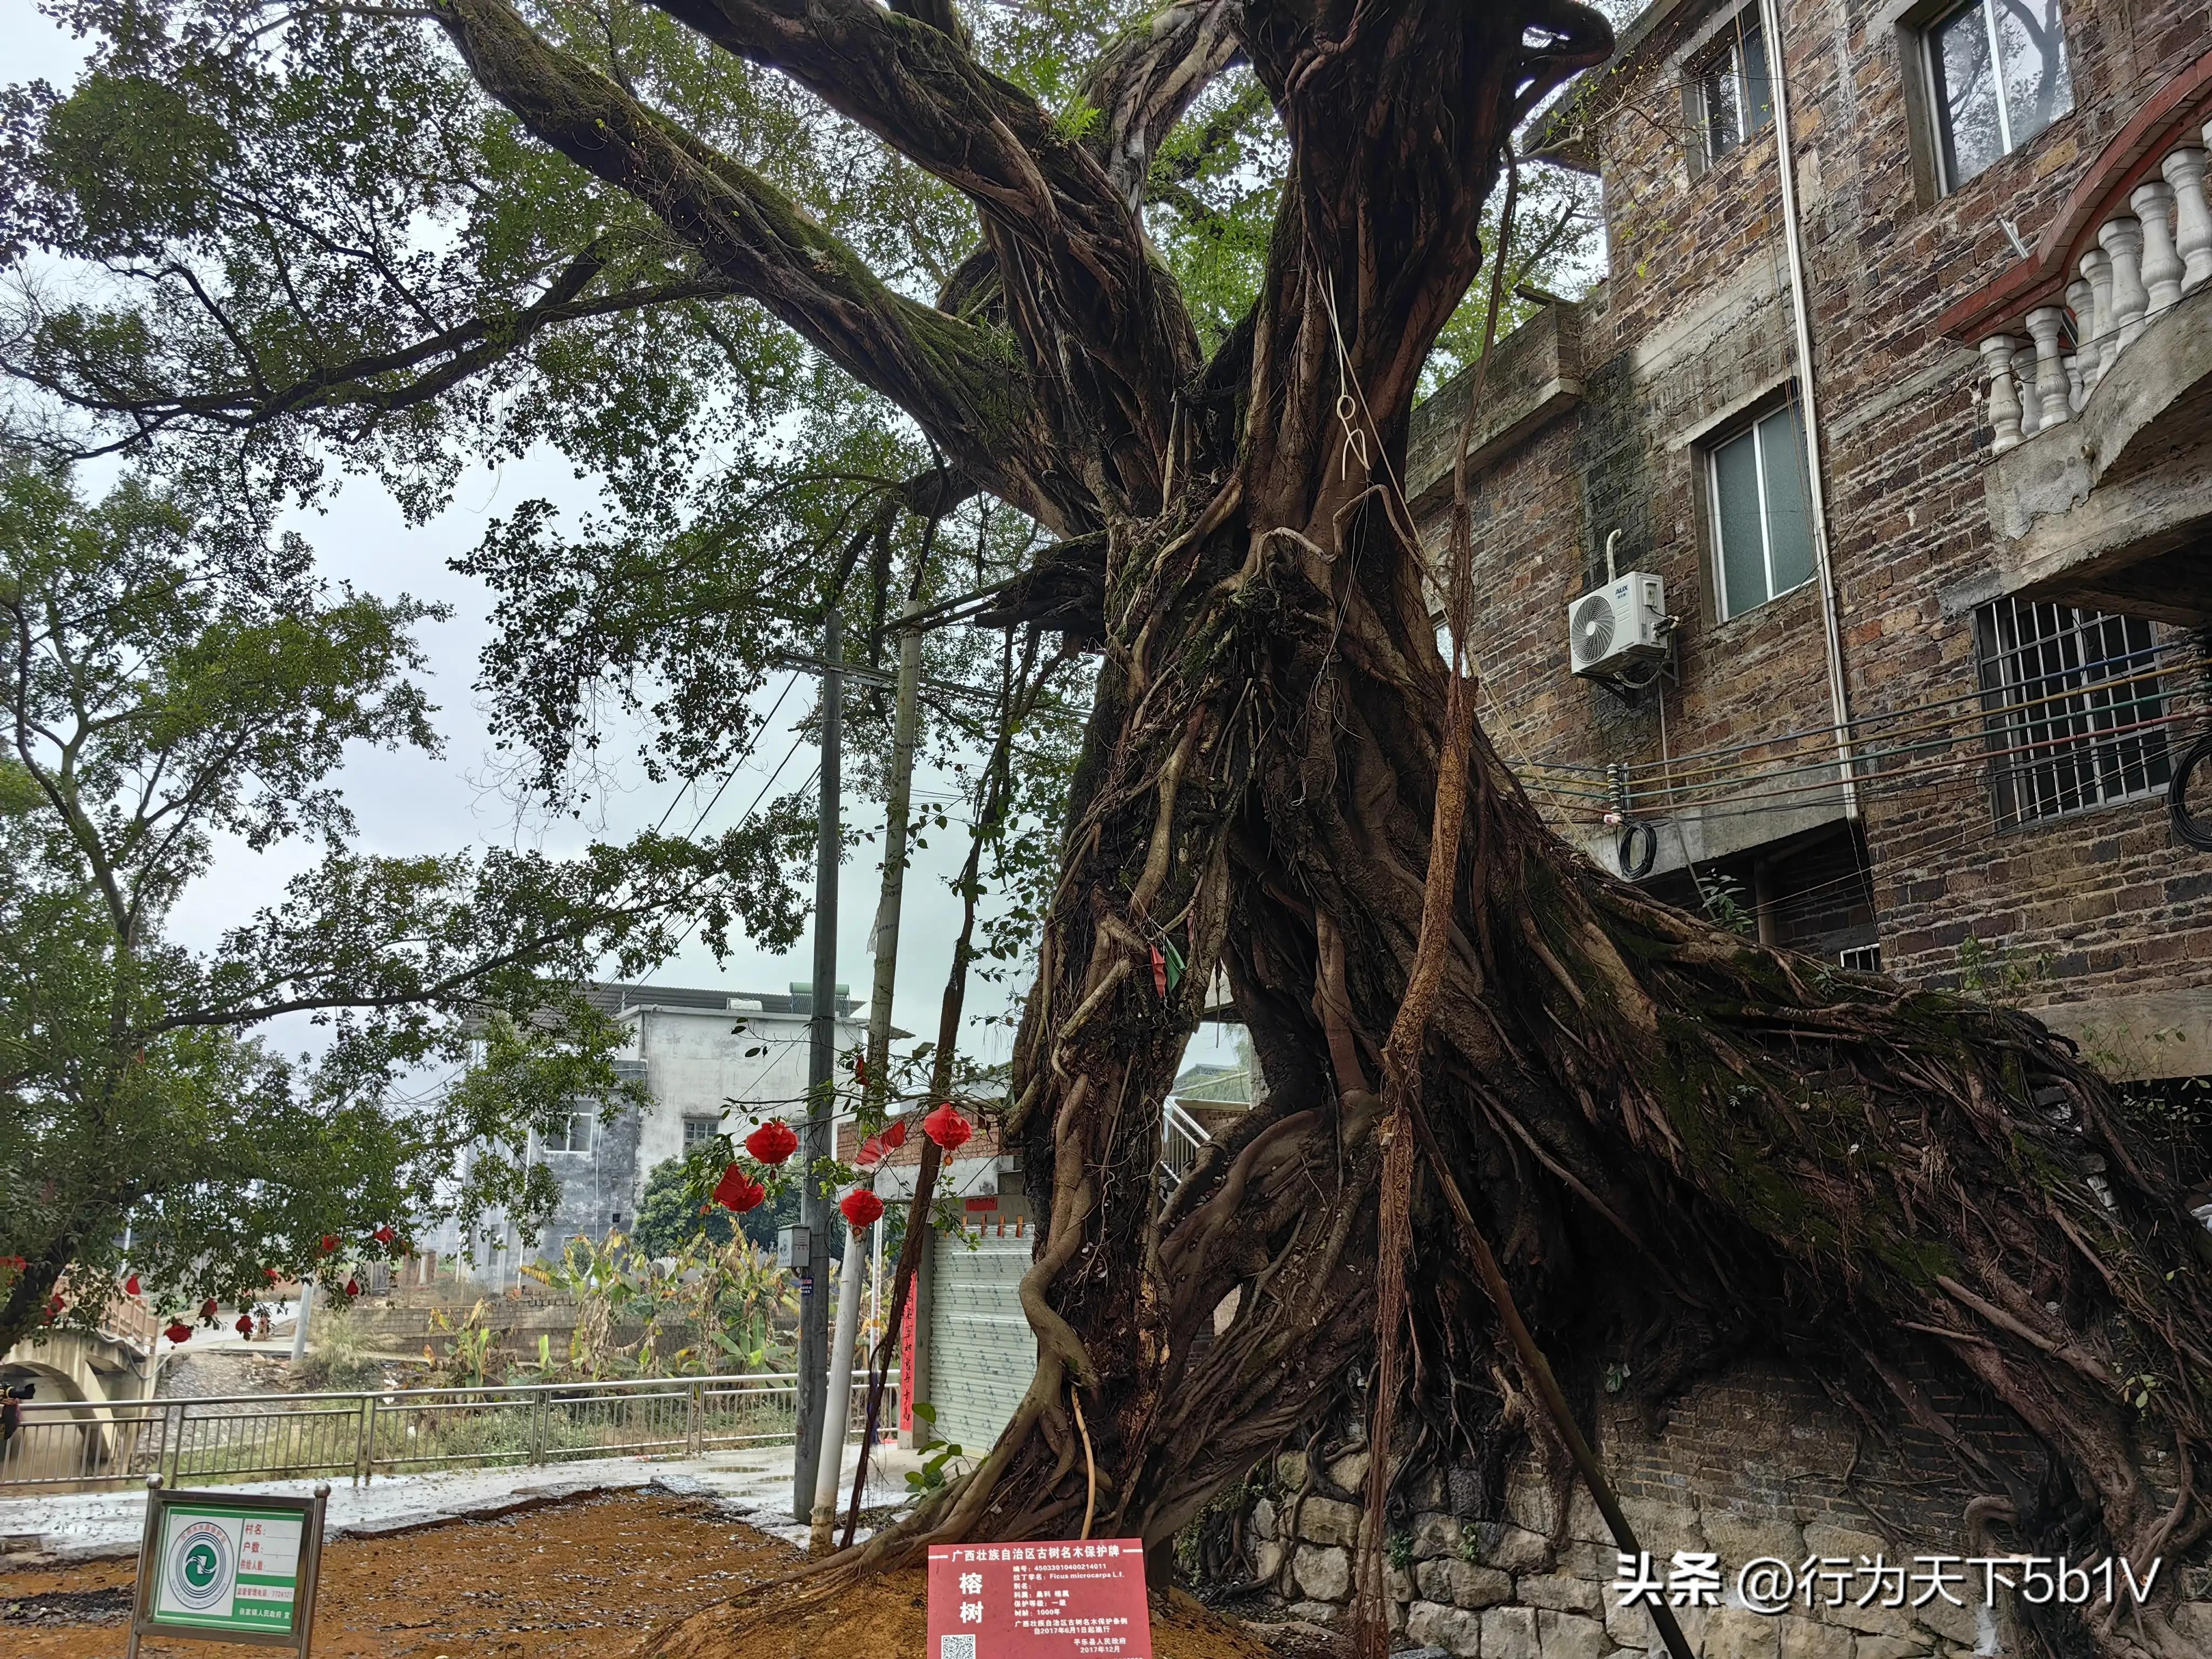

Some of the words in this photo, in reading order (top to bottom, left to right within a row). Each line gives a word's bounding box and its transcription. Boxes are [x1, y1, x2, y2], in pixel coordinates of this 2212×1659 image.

[1615, 585, 1628, 595] AUX
[245, 1523, 266, 1535] 村名：
[952, 1545, 1120, 1562] 广西壮族自治区古树名木保护牌
[959, 1572, 983, 1623] 榕树
[1015, 1617, 1128, 1628] 广西壮族自治区古树名木保护条例
[1034, 1626, 1110, 1635] 自2017年6月1日起施行
[1074, 1637, 1126, 1645] 平乐县人民政府
